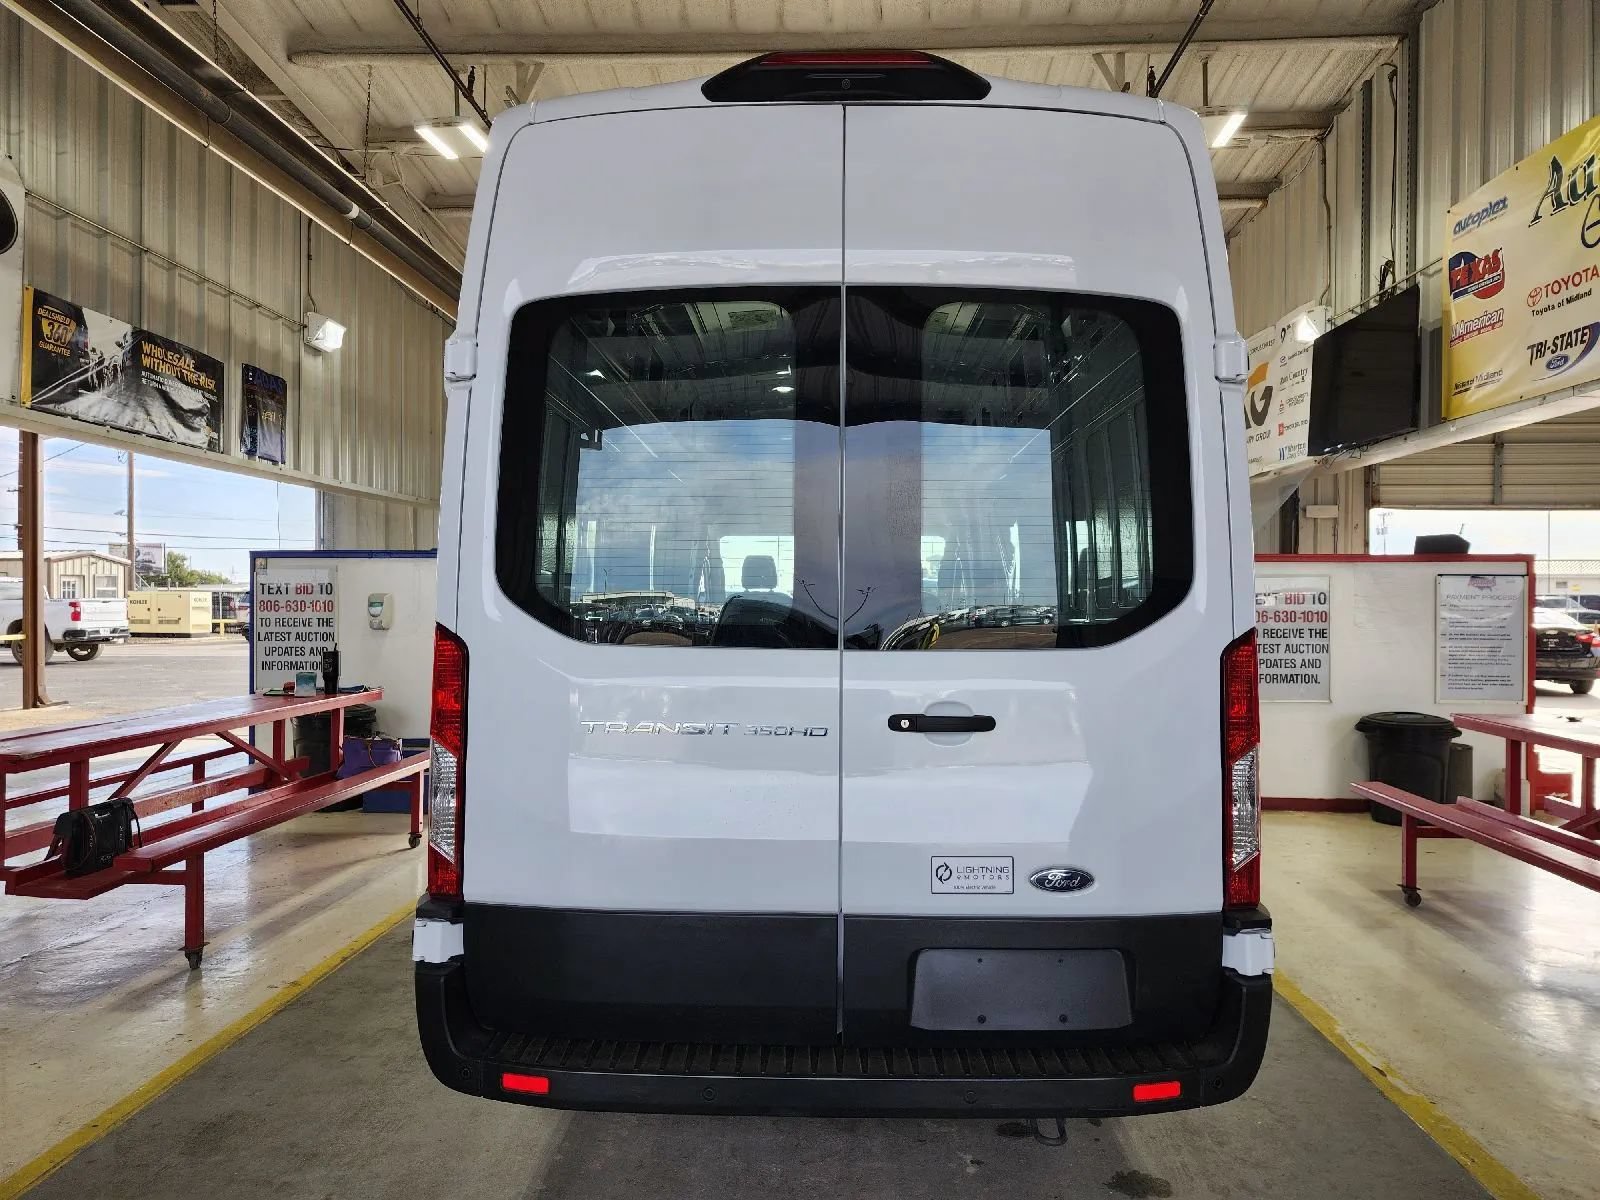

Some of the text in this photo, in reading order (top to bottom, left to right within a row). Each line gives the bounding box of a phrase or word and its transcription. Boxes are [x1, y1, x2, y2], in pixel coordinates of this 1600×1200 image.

[1453, 195, 1509, 235] autoplex
[1450, 248, 1502, 291] TEXAS
[1544, 264, 1600, 298] TOYOTA
[1531, 288, 1592, 317] Toyota of Midland
[37, 307, 70, 325] DEALSHIELD
[38, 340, 71, 357] GUARANTEE
[1526, 324, 1590, 366] TRI-STATE
[141, 340, 196, 372] WHOLESALE
[141, 353, 181, 378] WITHOUT
[181, 369, 199, 386] THE
[259, 582, 333, 595] TEXT BID TO
[258, 599, 334, 613] 806-630-1010
[1285, 592, 1305, 605] BID
[1311, 592, 1327, 605] TO
[259, 617, 334, 627] TO RECEIVE THE
[257, 631, 335, 642] LATEST AUCTION
[1263, 629, 1304, 639] RECEIVE
[1308, 629, 1328, 639] THE
[264, 646, 306, 657] UPDATES
[1257, 643, 1329, 654] TEST AUCTION
[1259, 658, 1322, 669] PDATES AND
[1259, 673, 1321, 684] FORMATION.
[581, 720, 829, 737] TRANSIT 350HD
[1044, 872, 1081, 888] Ford
